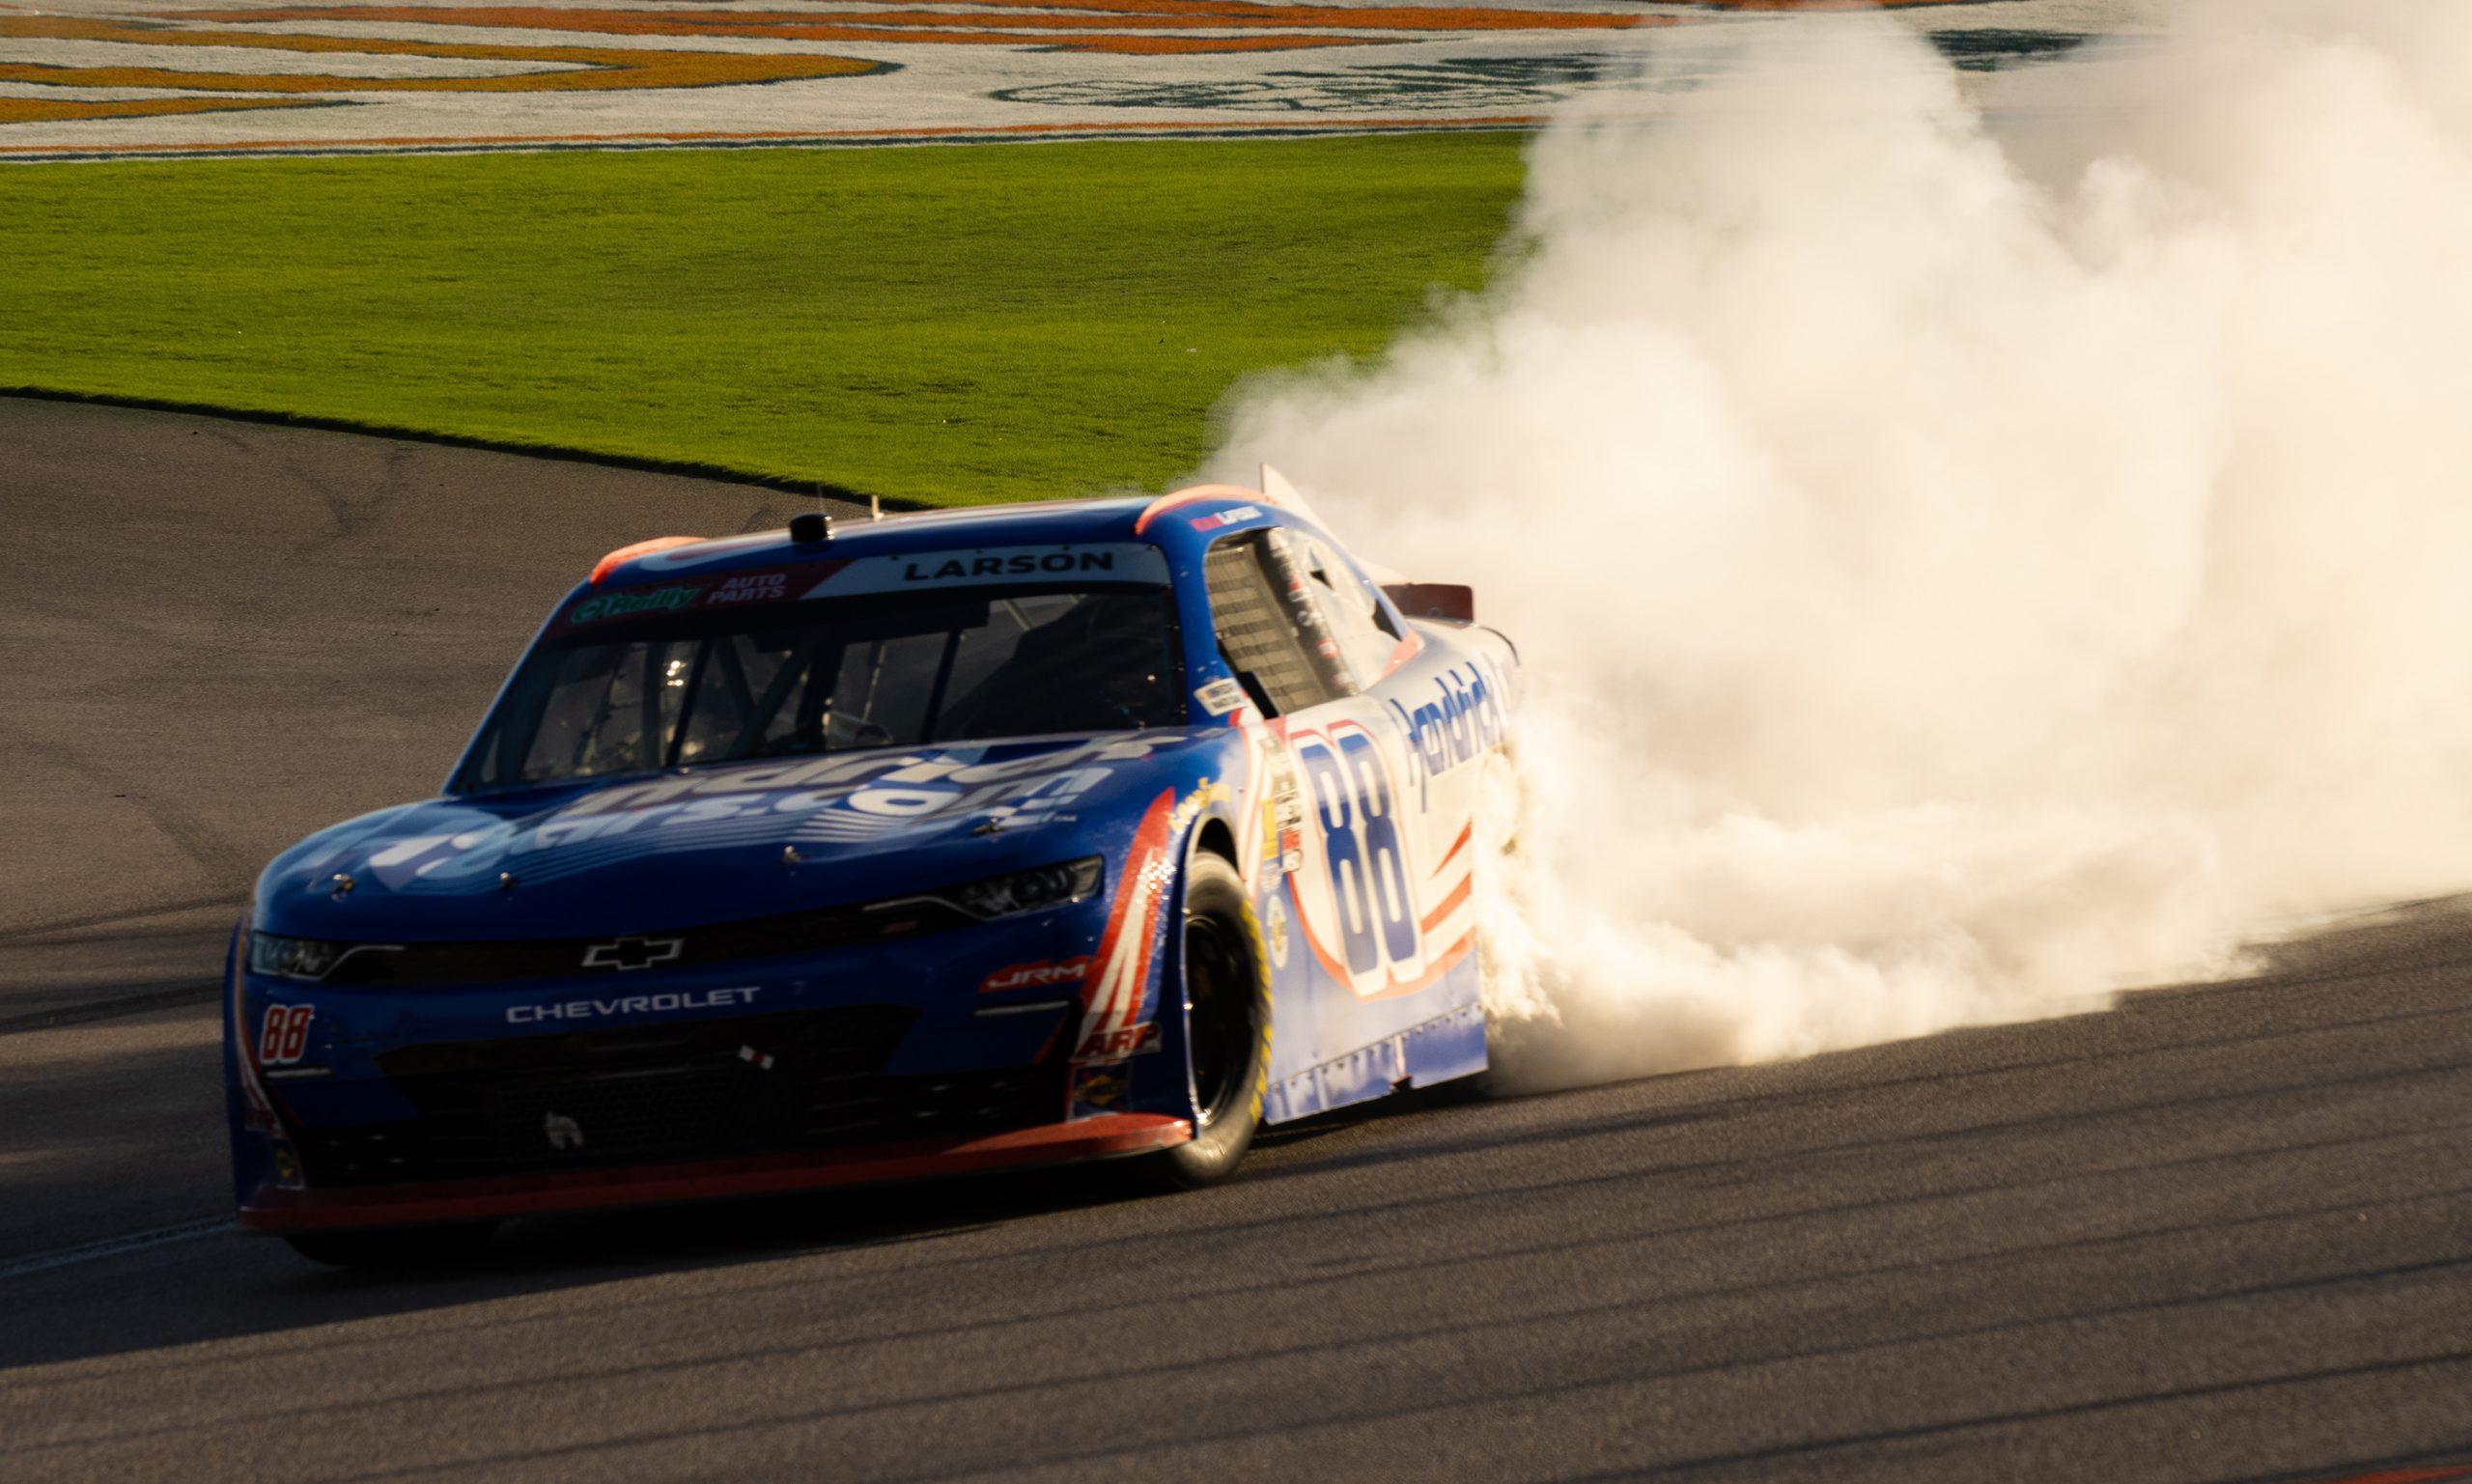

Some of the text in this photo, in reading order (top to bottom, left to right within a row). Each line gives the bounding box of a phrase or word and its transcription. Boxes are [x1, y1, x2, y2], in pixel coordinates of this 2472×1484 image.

[722, 574, 786, 590] AUTO
[903, 550, 1114, 581] LARSON
[706, 585, 787, 603] PARTS
[1296, 726, 1422, 987] 88
[987, 962, 1087, 988] JRM
[505, 985, 763, 1024] CHEVROLET
[260, 1004, 315, 1064] 88
[1073, 1022, 1162, 1059] ARP
